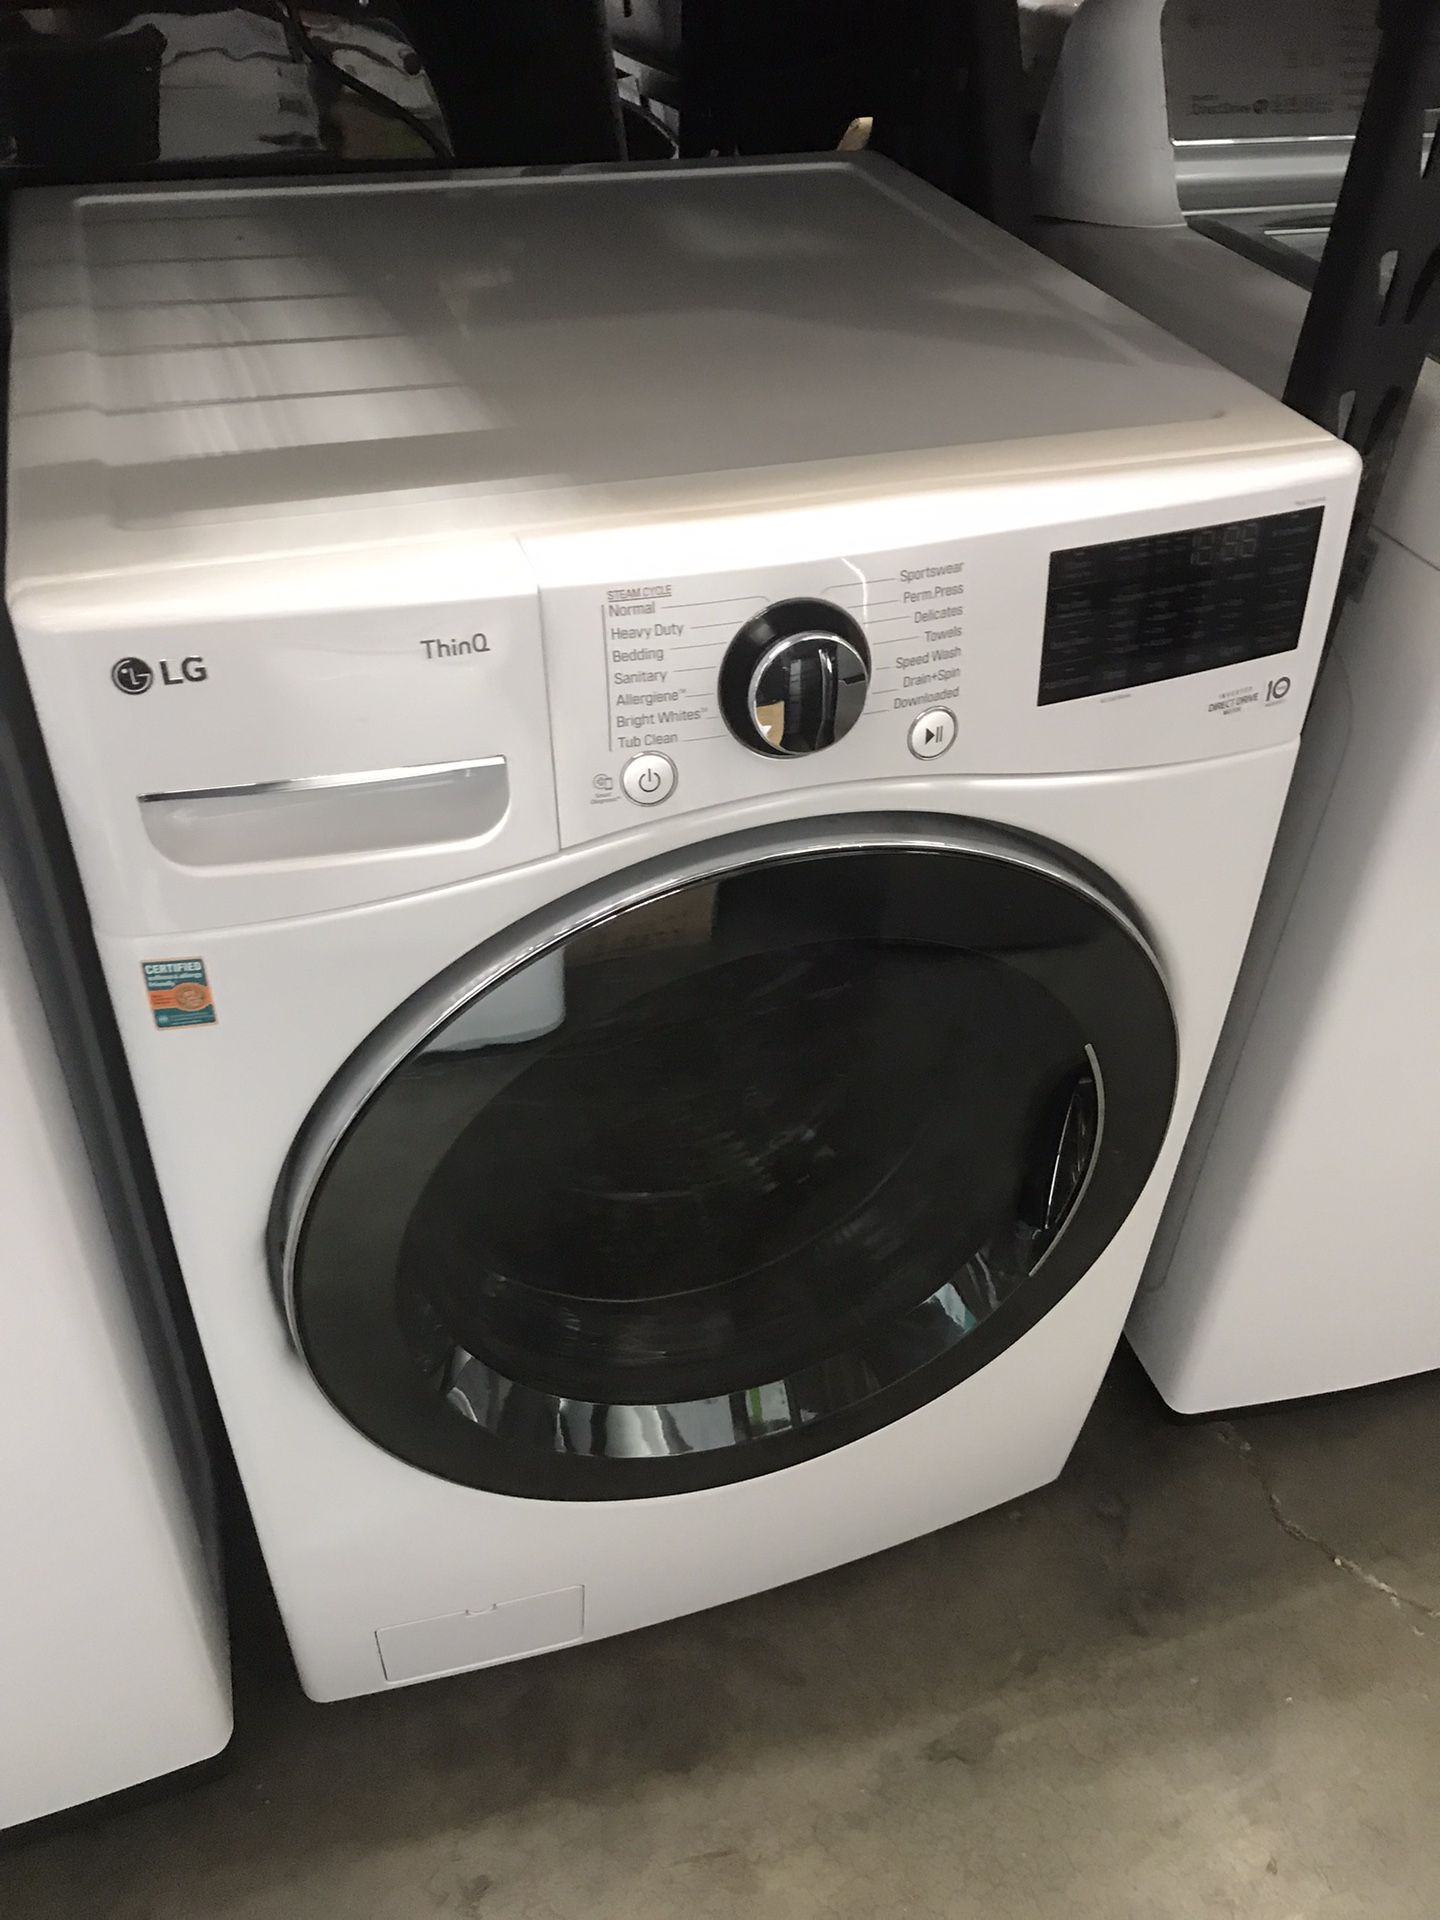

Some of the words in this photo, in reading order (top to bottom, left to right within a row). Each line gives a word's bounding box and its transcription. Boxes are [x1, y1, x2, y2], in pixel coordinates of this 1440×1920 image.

[900, 562, 964, 583] Sportswear
[607, 588, 641, 601] STEAM
[642, 584, 672, 597] CYCLE
[608, 601, 656, 617] Normal
[914, 605, 963, 624] Delicates
[611, 626, 652, 640] Heavy
[654, 623, 684, 637] Duty
[925, 626, 963, 643] Towels
[420, 633, 491, 659] ThinQ
[612, 647, 664, 663] Bedding
[896, 653, 929, 670] Speed
[932, 646, 962, 662] Wash
[158, 655, 208, 686] LG
[614, 671, 668, 685] Sanitary
[903, 667, 961, 688] Drain+Spin
[893, 686, 960, 709] Downloaded
[1265, 676, 1291, 702] 10
[1208, 698, 1236, 712] DIRECT
[1236, 692, 1259, 706] DRIVE
[616, 713, 656, 728] Bright
[618, 736, 642, 748] Tub
[644, 733, 678, 746] Clean
